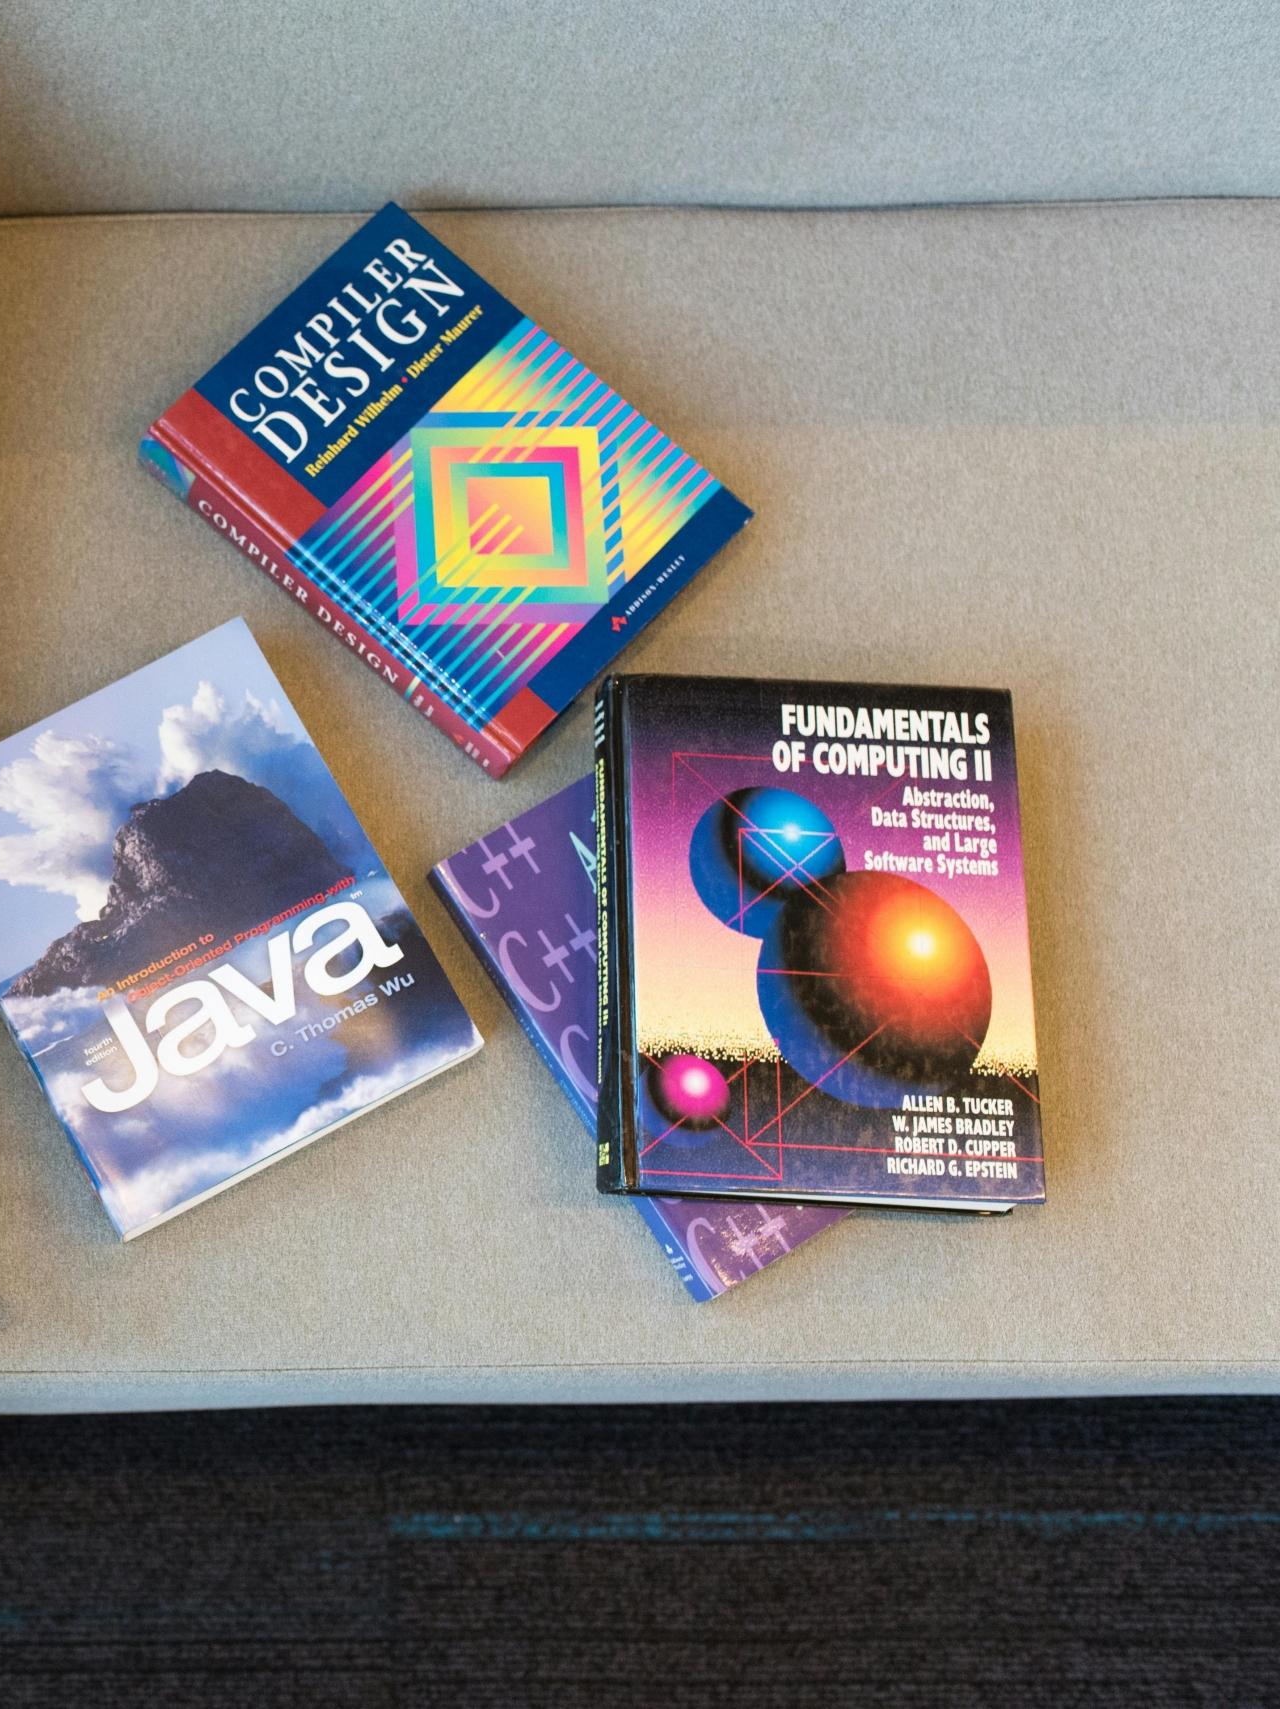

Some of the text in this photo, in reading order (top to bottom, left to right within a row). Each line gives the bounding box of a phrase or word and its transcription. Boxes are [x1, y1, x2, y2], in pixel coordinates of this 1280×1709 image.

[230, 238, 427, 422] COMPILER
[253, 259, 464, 464] DESIGN
[305, 305, 483, 477] Reinhard Wilhelm Dieter Maurer
[198, 500, 398, 684] COMPILER DESIGN
[781, 703, 991, 745] FUNDAMENTALS
[772, 740, 992, 782] OF COMPUTING II
[871, 806, 996, 834] Data Structures,
[902, 786, 995, 813] Abstraction,
[598, 757, 607, 885] FUNDAMENTALS
[864, 850, 999, 880] Software Systems
[923, 832, 998, 858] and Large
[234, 891, 326, 944] Programming
[326, 875, 356, 898] with
[117, 941, 197, 991] Introduction
[199, 933, 215, 945] to
[601, 908, 609, 1005] COMPUTING
[80, 901, 405, 1113] Java
[270, 973, 415, 1057] C. Thomas Wu
[83, 1036, 113, 1057] fourth
[85, 1045, 118, 1067] edition
[892, 1115, 1015, 1137] W. JAMES BRADLEY
[902, 1095, 1013, 1116] ALLEN B. TUCKER
[894, 1136, 1016, 1157] ROBERT D. CUPPER
[887, 1157, 1018, 1179] RICHARD G. EPSTEIN
